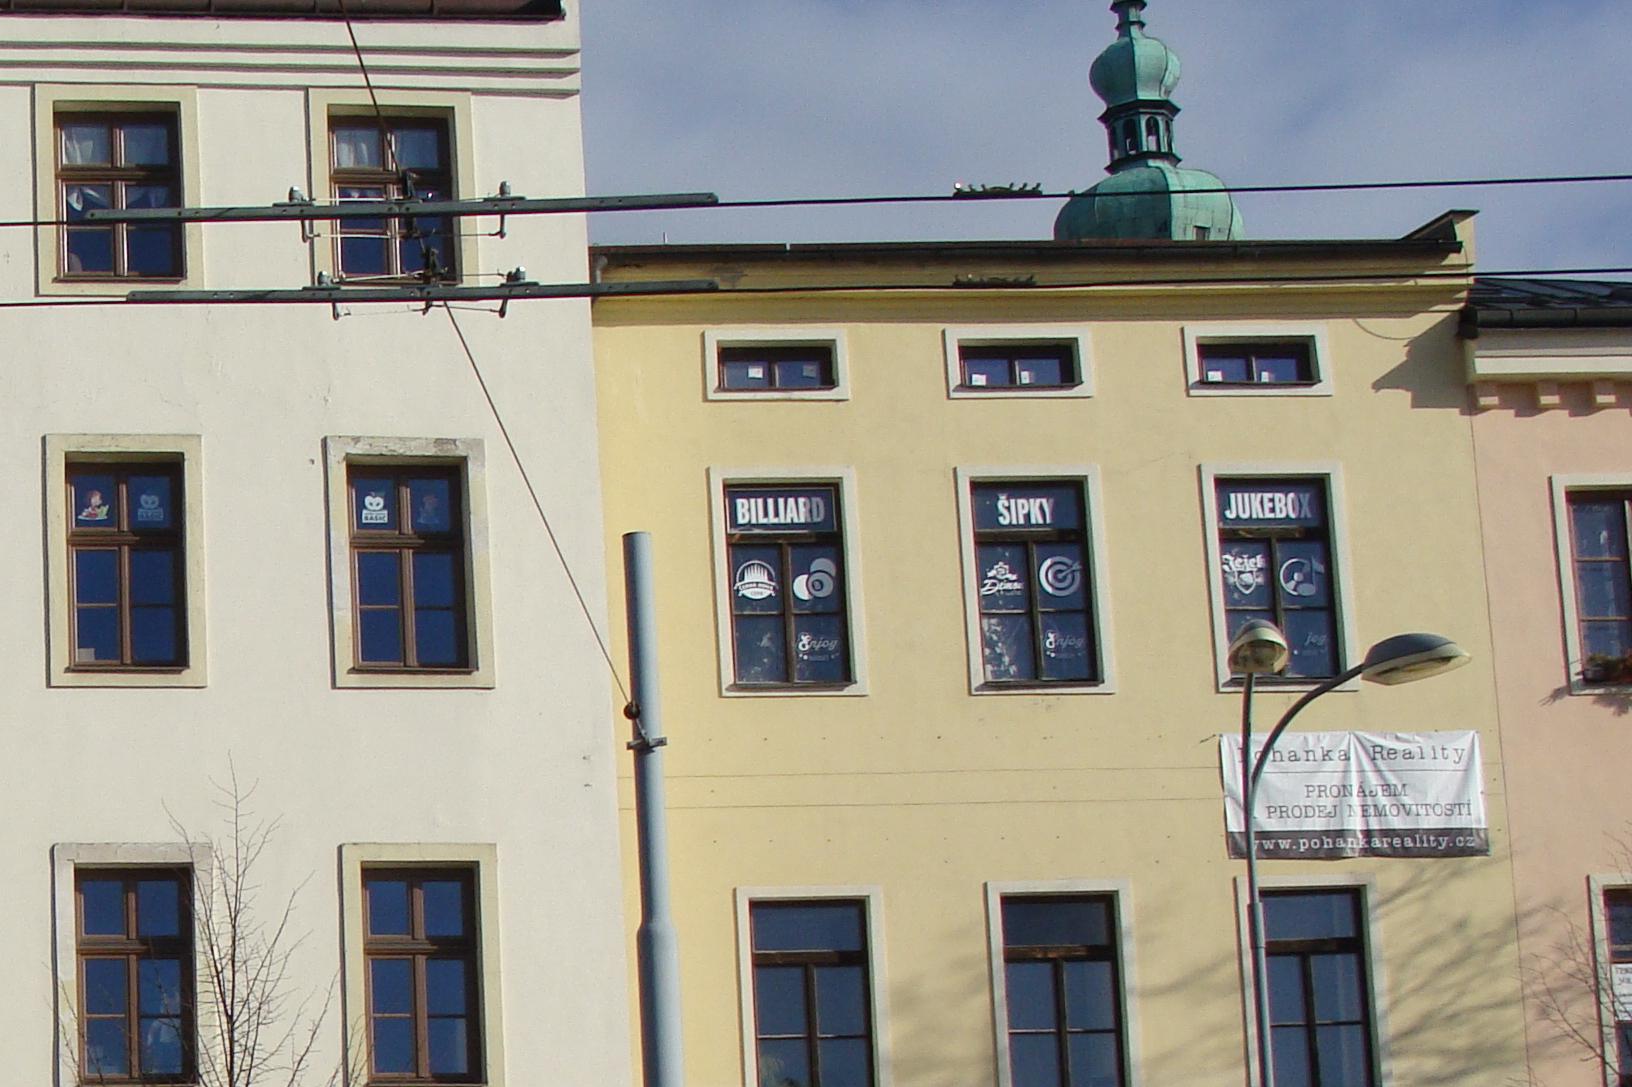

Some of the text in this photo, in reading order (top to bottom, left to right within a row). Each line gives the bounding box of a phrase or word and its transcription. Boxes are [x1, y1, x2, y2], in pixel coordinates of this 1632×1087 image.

[735, 497, 825, 525] BILLIARD
[997, 494, 1055, 525] ŠIPKY
[1225, 492, 1313, 519] JUKEBOX
[1371, 744, 1466, 765] Reality
[1304, 781, 1408, 799] PRONÁJEM
[1265, 804, 1338, 819] PRODEJ
[1347, 799, 1473, 818] NEMOVITOSTÍ
